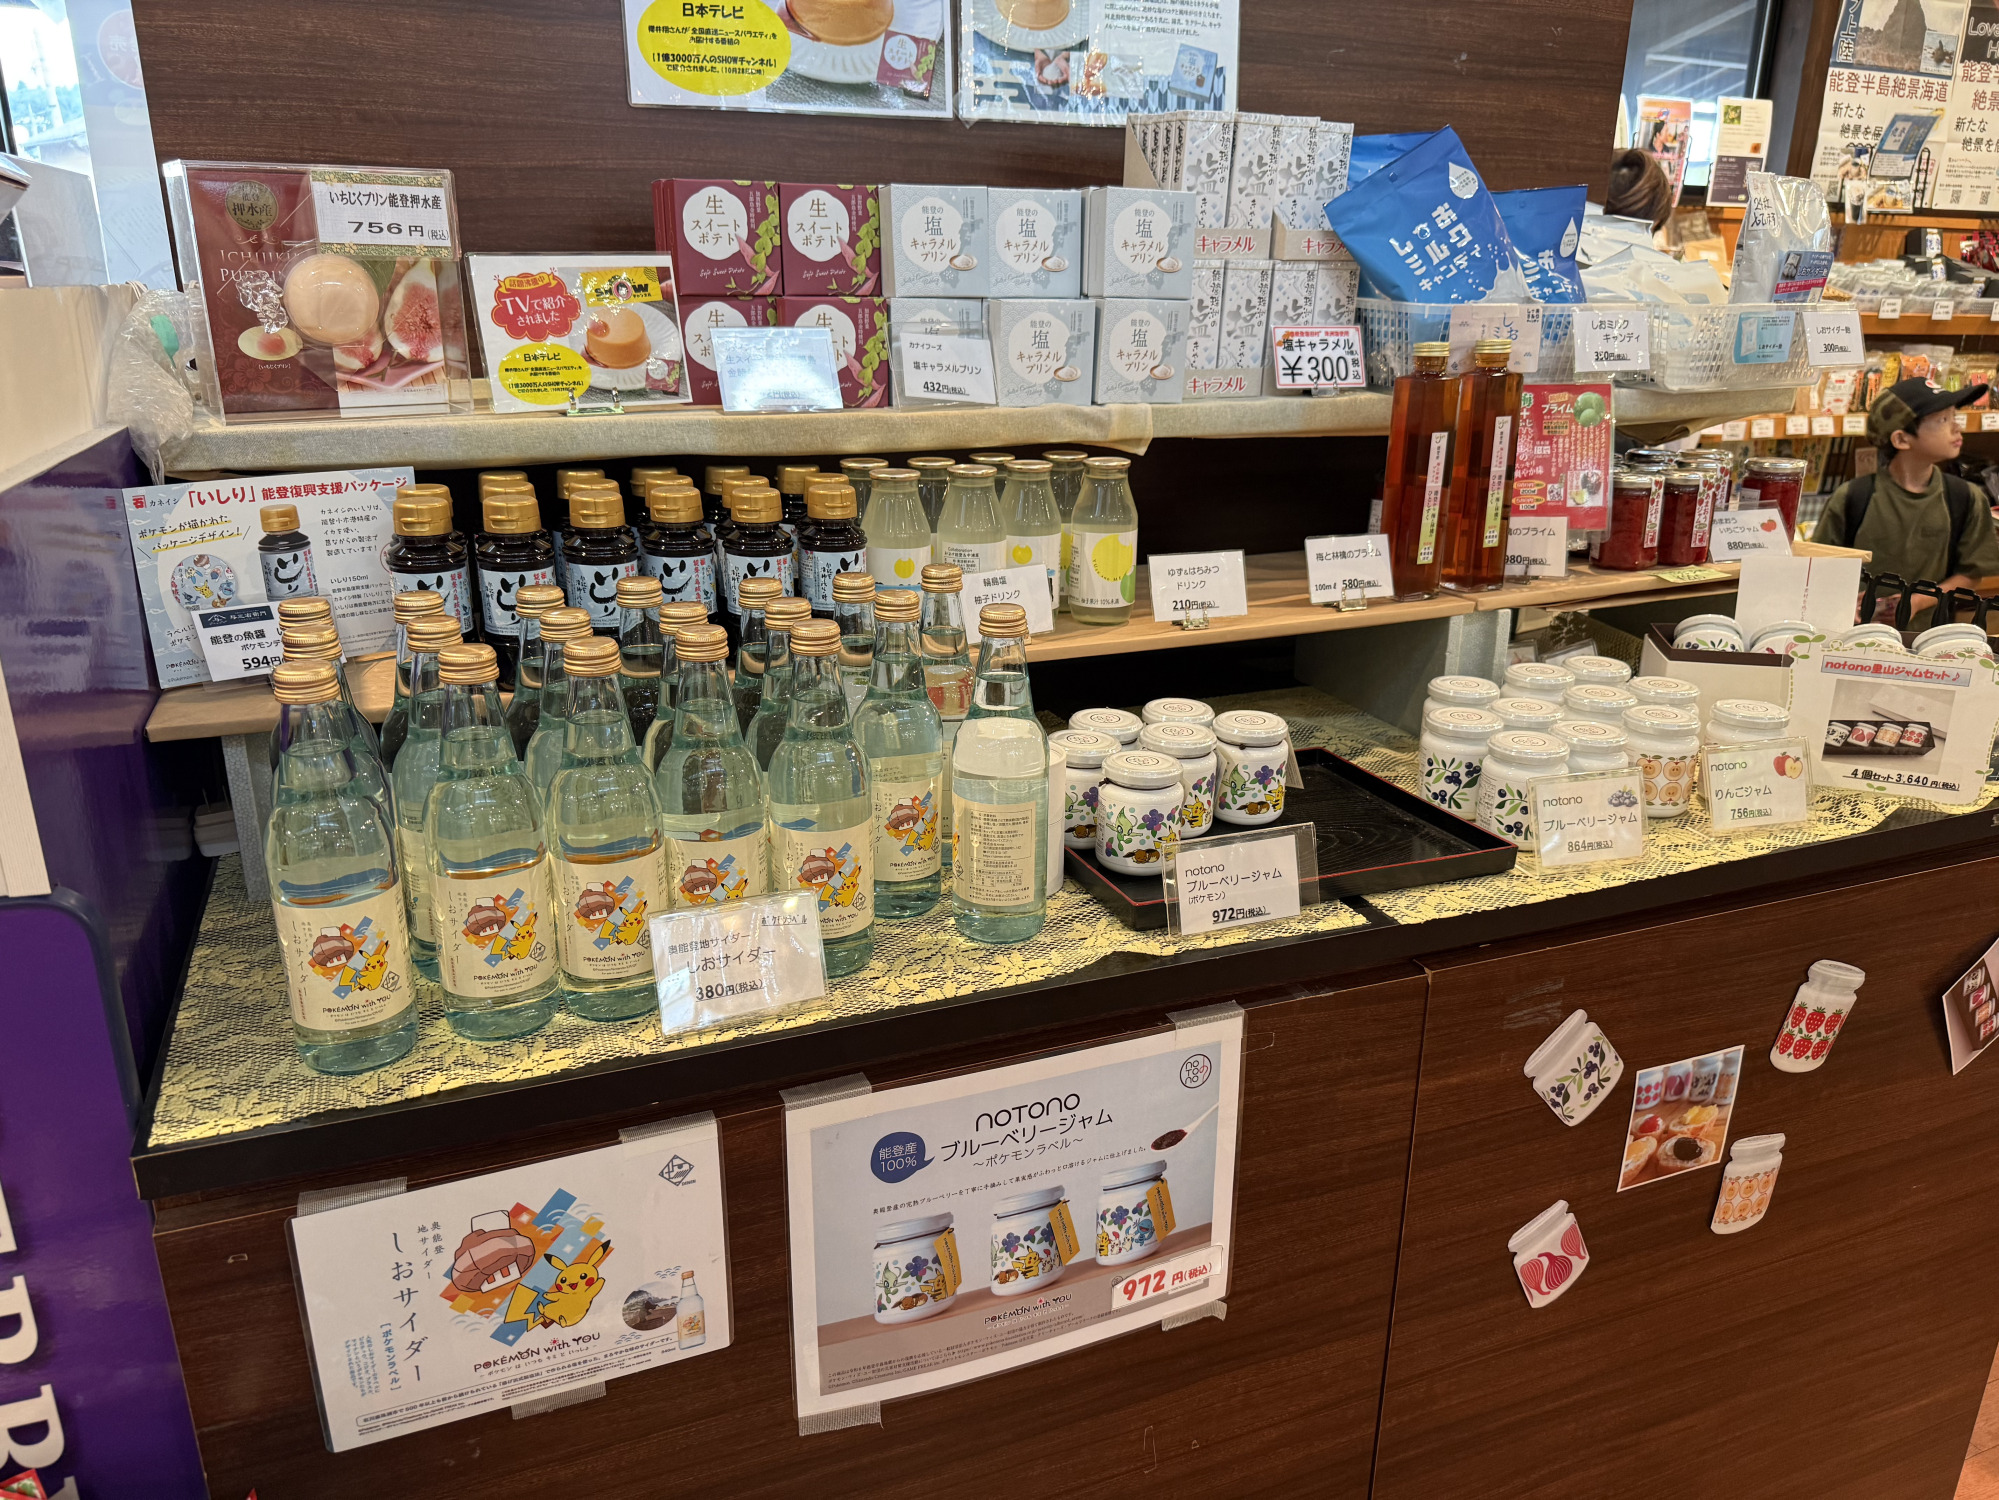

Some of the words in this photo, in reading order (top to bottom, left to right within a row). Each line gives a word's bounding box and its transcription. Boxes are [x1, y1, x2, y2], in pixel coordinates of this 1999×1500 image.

[682, 2, 745, 20] 日本テレビ
[1829, 69, 1948, 103] 能登半島絶景海道
[1832, 101, 1866, 119] 新たな
[1954, 116, 1988, 133] 新たな
[328, 190, 442, 211] いちじくプリン能登押水産
[705, 194, 725, 215] 生
[809, 198, 828, 218] 生
[232, 202, 273, 217] 押水産
[921, 206, 944, 216] 能登の
[1016, 207, 1038, 217] 能登の
[1134, 208, 1155, 218] 能登の
[691, 219, 741, 232] スイート
[795, 221, 843, 234] スイート
[924, 216, 943, 236] 塩
[1018, 218, 1037, 238] 塩
[1136, 218, 1153, 238] 塩
[698, 232, 735, 245] ポテト
[802, 235, 837, 248] ポテト
[910, 237, 956, 250] キャラメル
[1003, 239, 1050, 252] キャラメル
[1121, 239, 1165, 253] キャラメル
[1196, 235, 1255, 254] キャラメル
[920, 251, 948, 263] プリン
[1014, 252, 1039, 264] プリン
[1130, 252, 1155, 264] プリン
[501, 294, 566, 316] TVで紹介
[516, 312, 560, 327] されました
[707, 309, 727, 328] 生
[815, 312, 833, 328] 生
[1029, 319, 1052, 328] 能登の
[1130, 319, 1150, 328] 能登の
[1602, 332, 1640, 343] キャンディ
[1816, 326, 1851, 334] しおサイダー飴
[1031, 330, 1050, 349] 塩
[1131, 329, 1147, 348] 塩
[1282, 338, 1354, 351] 塩キャラメル
[523, 352, 562, 362] 日本テレビ
[1016, 351, 1062, 363] キャラメル
[1116, 350, 1158, 362] キャラメル
[913, 361, 982, 375] 塩キャラメルプリン
[1025, 363, 1051, 375] プリン
[1124, 361, 1149, 373] プリン
[1281, 355, 1349, 384] ¥300
[1351, 358, 1361, 380] 税込
[923, 381, 966, 395] 432円(税込)
[1187, 378, 1246, 394] キャラメル
[187, 486, 256, 508] 「いしり」
[261, 476, 408, 501] 能登復興支援パッケージ
[150, 498, 180, 507] カネイシ
[1703, 492, 1711, 522] あまおう
[138, 514, 229, 538] ポケモンが描かれた
[1719, 525, 1760, 533] いちごジャム
[330, 574, 369, 584] いしり150ml
[983, 576, 1007, 587] 輪島塩
[1176, 580, 1207, 591] ドリンク
[974, 590, 1021, 605] 柚子ドリンク
[1172, 598, 1218, 611] 210円(税込)
[210, 629, 266, 645] 能登の魚醤
[1710, 760, 1748, 772] notono
[1542, 794, 1583, 808] notono
[1714, 785, 1773, 801] りんごジャム
[1543, 811, 1638, 832] ブルーベリージャム
[1730, 807, 1772, 820] 756円(税込)
[1567, 839, 1614, 852] 864円(税込)
[1185, 862, 1226, 878] notono
[1186, 867, 1282, 893] ブルーベリージャム
[1212, 905, 1267, 922] 972円(税込)
[448, 891, 461, 964] しおサイダー
[668, 931, 751, 955] 奥能登地サイダー
[687, 946, 777, 974] しおサイダー
[941, 1109, 1114, 1162] ブルーベリージャム
[878, 1142, 918, 1161] 能登産
[879, 1156, 918, 1173] 100%
[430, 1221, 445, 1255] 奥能登
[417, 1224, 433, 1280] 地サイダー
[391, 1232, 429, 1382] しおサイダー
[984, 1305, 1031, 1325] POKÉMON
[1033, 1300, 1051, 1311] with
[1052, 1293, 1072, 1304] YOU
[474, 1347, 541, 1374] POKÉMON
[543, 1338, 571, 1354] with
[572, 1332, 601, 1346] YOU
